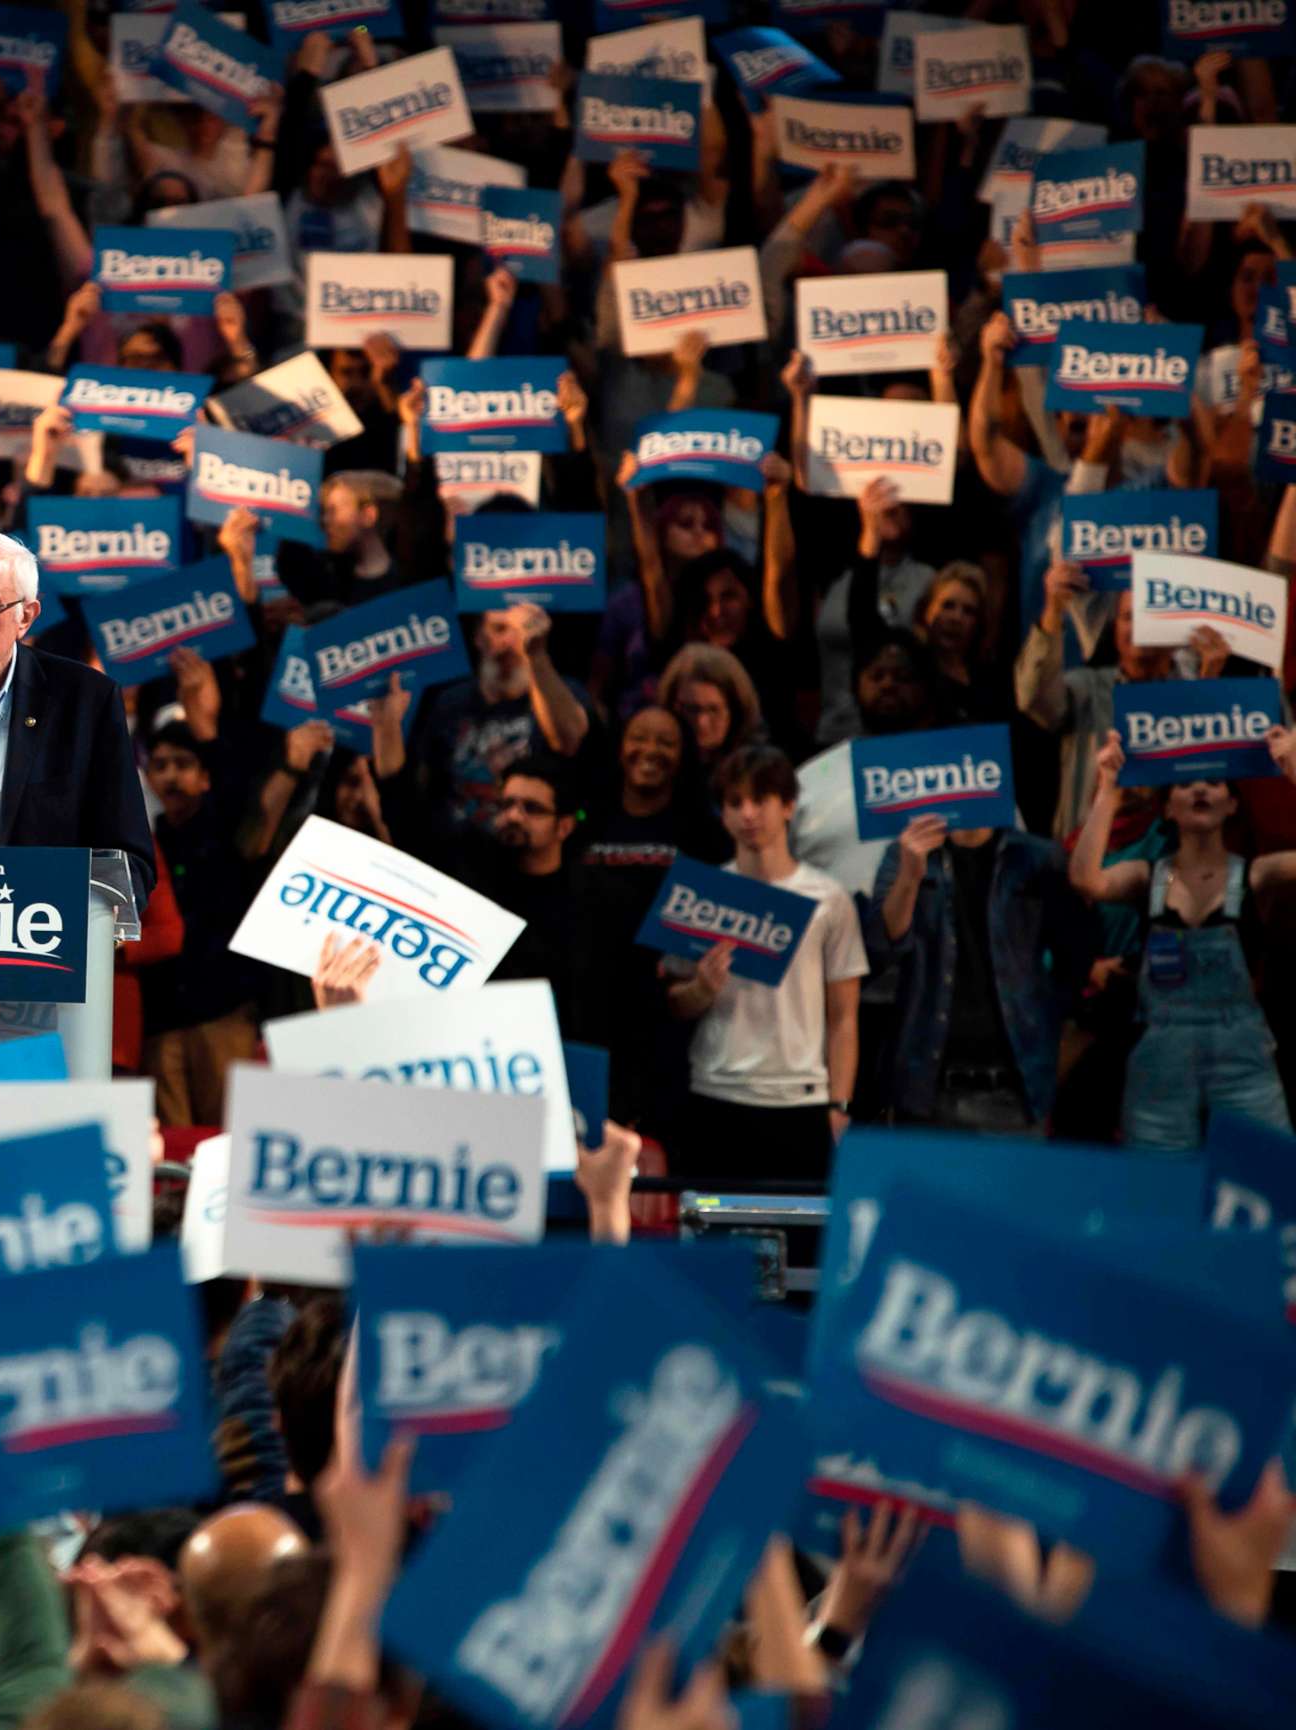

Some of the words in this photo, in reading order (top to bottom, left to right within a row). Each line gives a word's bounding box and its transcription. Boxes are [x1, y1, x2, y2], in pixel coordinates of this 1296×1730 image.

[165, 23, 273, 98] Bernie
[929, 55, 1024, 88] Bernie
[340, 80, 451, 136] Bernie
[582, 98, 697, 138] Bernie
[787, 118, 902, 153] Bernie
[1203, 153, 1296, 187] Bern
[1035, 170, 1138, 216] Bernie
[100, 248, 225, 284] Bernie
[320, 282, 440, 315] Bernie
[630, 278, 752, 320] Bernie
[1012, 290, 1141, 333] Bernie
[811, 302, 936, 338] Bernie
[1060, 344, 1190, 384] Bernie
[69, 377, 196, 413] Bernie
[427, 384, 558, 420] Bernie
[640, 428, 764, 462] Bernie
[820, 428, 943, 464] Bernie
[196, 452, 313, 507] Bernie
[437, 457, 528, 483] ernie
[38, 523, 171, 562] Bernie
[1070, 517, 1208, 556] Bernie
[464, 540, 597, 578] Bernie
[99, 590, 235, 656] Bernie
[1146, 577, 1275, 630] Bernie
[315, 614, 452, 679] Bernie
[1125, 705, 1271, 746] Bernie
[861, 755, 1002, 798] Bernie
[280, 870, 472, 991] Bernie
[662, 884, 793, 951] Bernie
[253, 1128, 521, 1222] Bernie
[375, 1309, 561, 1405] Ber
[854, 1258, 1244, 1488] Bernie
[454, 1343, 739, 1726] Bernie
